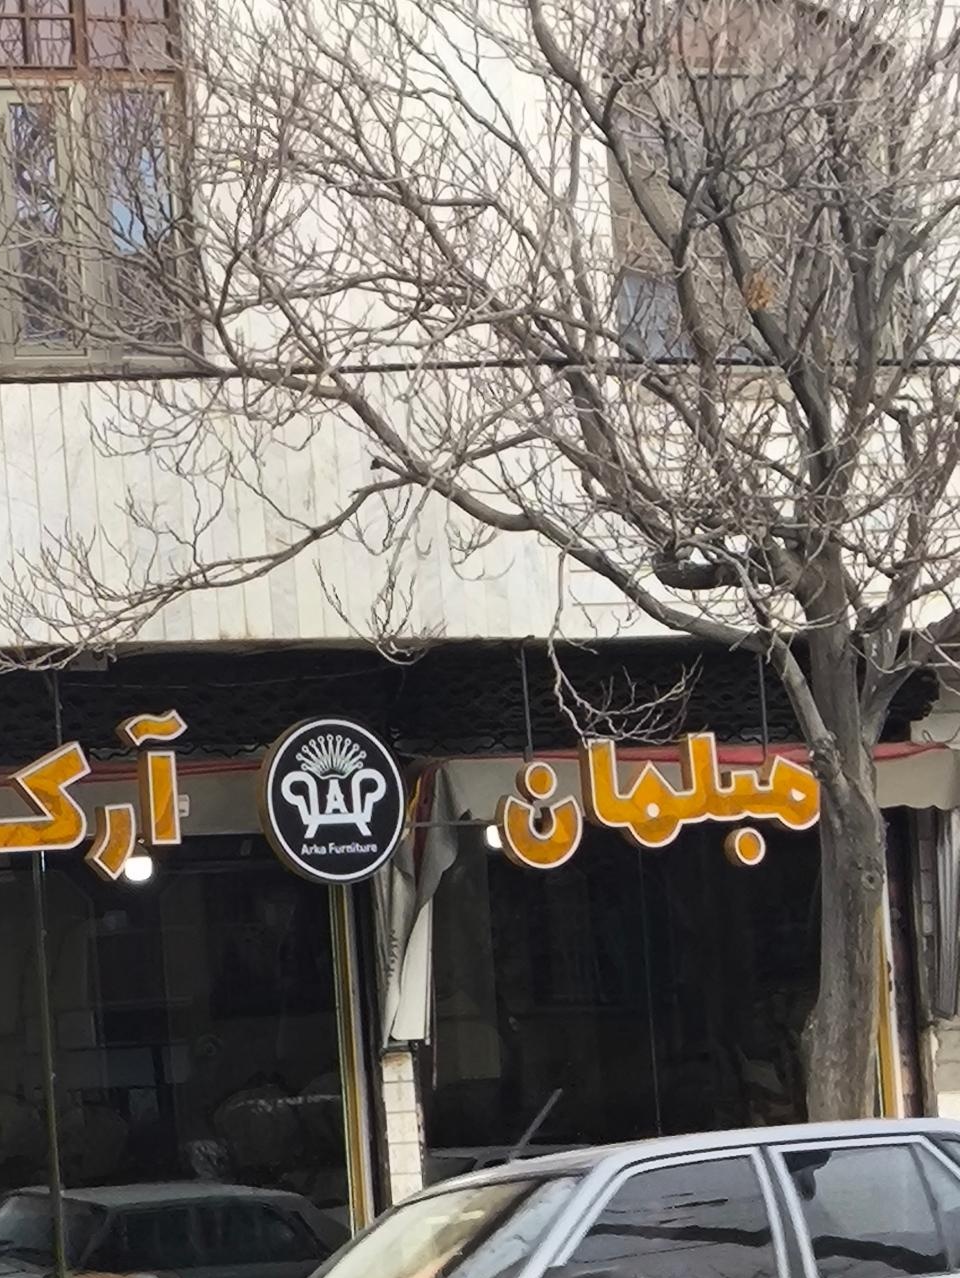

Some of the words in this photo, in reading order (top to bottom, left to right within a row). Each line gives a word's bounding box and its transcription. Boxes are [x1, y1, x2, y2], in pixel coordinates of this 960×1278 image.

[497, 732, 821, 869] مبلمان
[301, 843, 327, 856] Arka
[328, 842, 378, 856] Furniture
